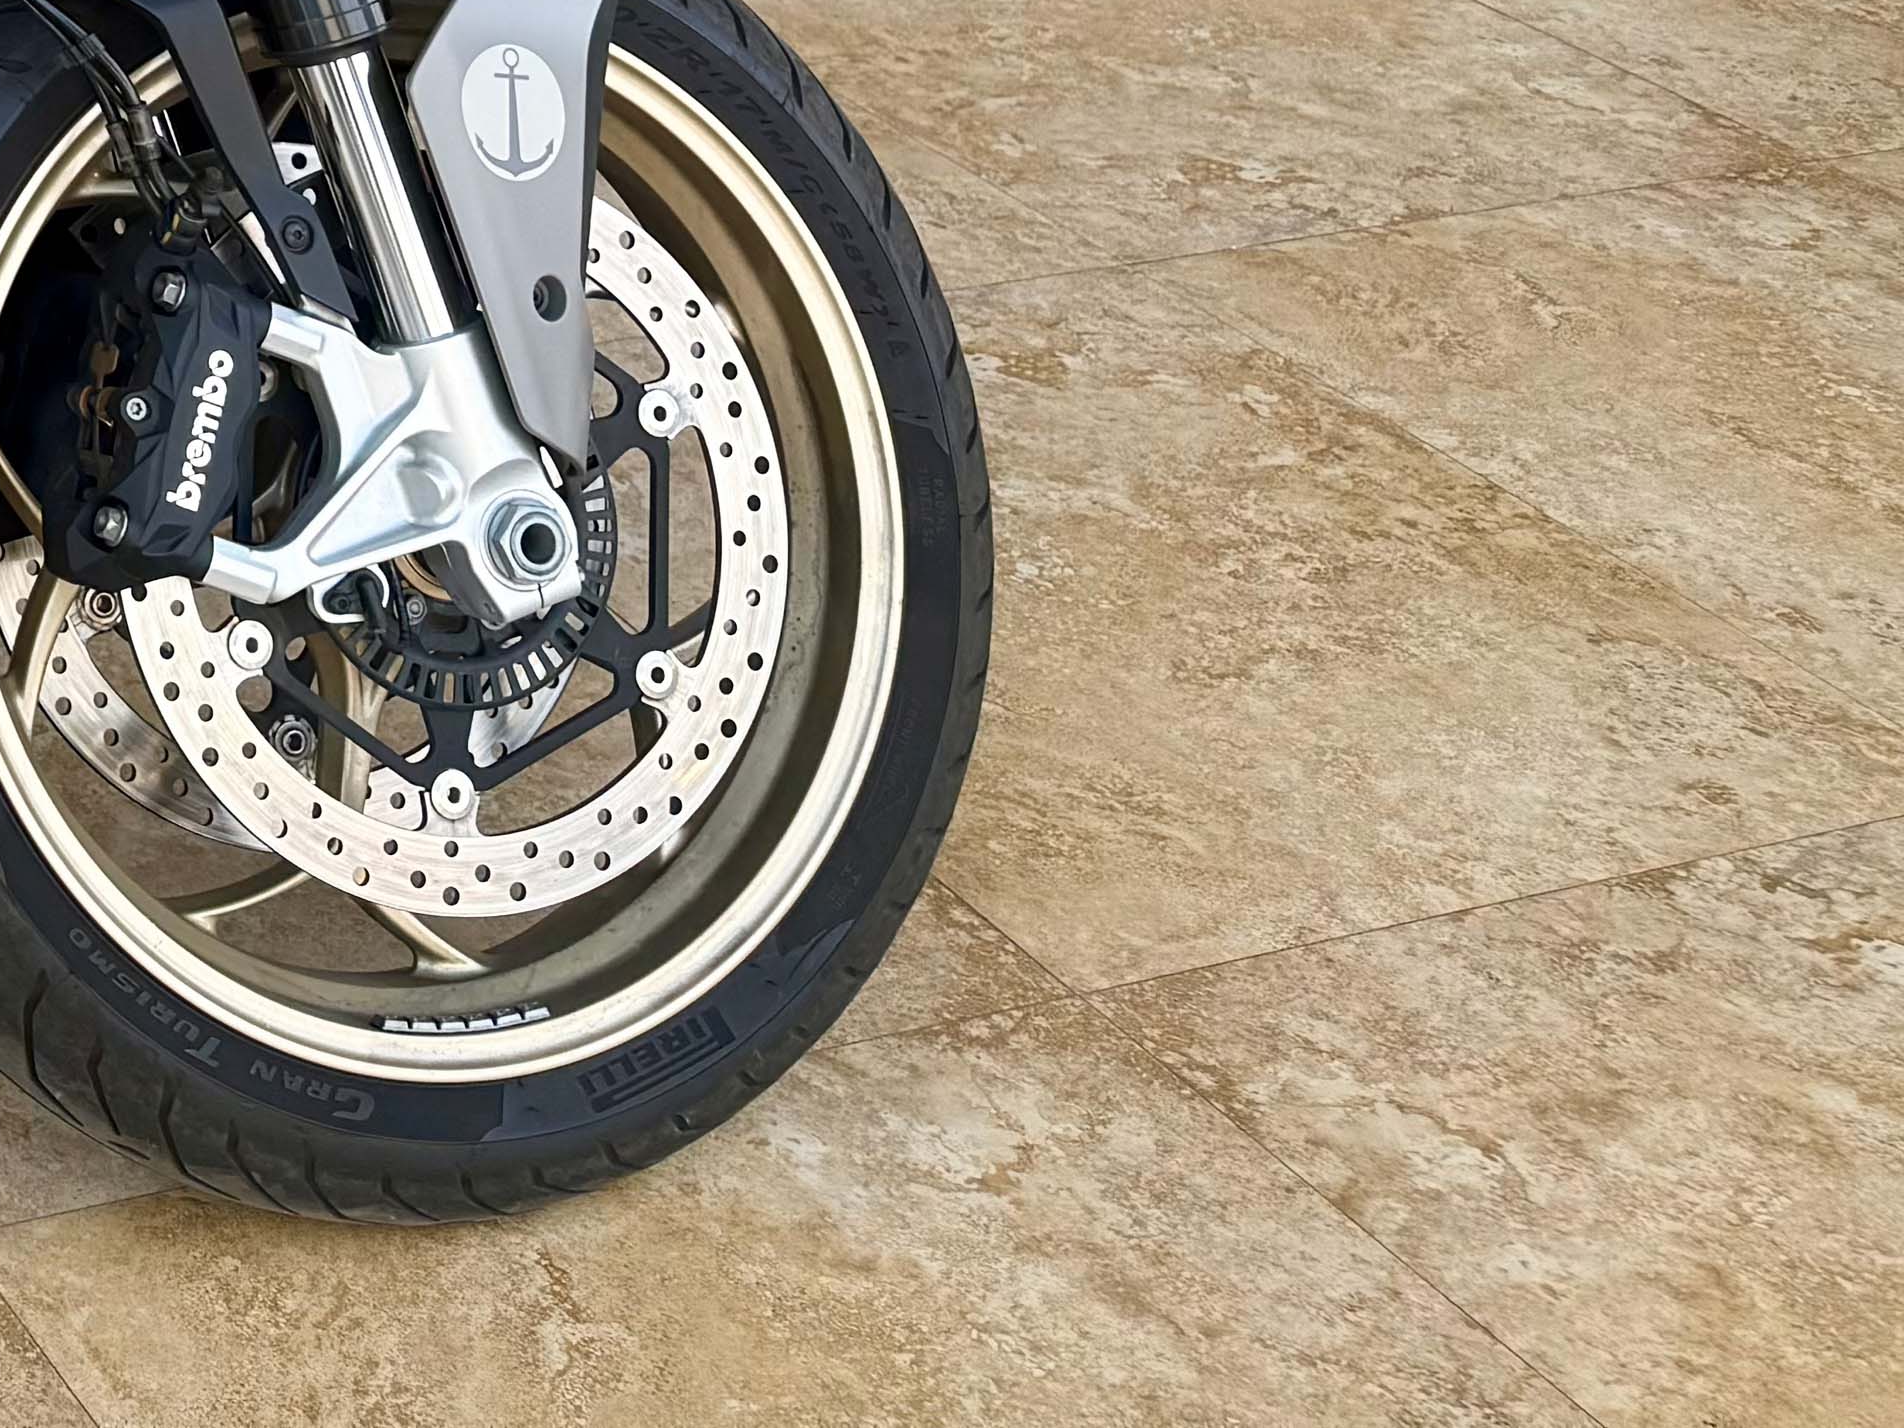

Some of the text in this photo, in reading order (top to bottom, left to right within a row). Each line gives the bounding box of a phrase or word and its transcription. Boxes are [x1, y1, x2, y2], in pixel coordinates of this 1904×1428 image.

[166, 349, 235, 513] brembo
[68, 927, 376, 1122] GRAN TURISMO
[576, 1004, 736, 1115] PIRELLI
